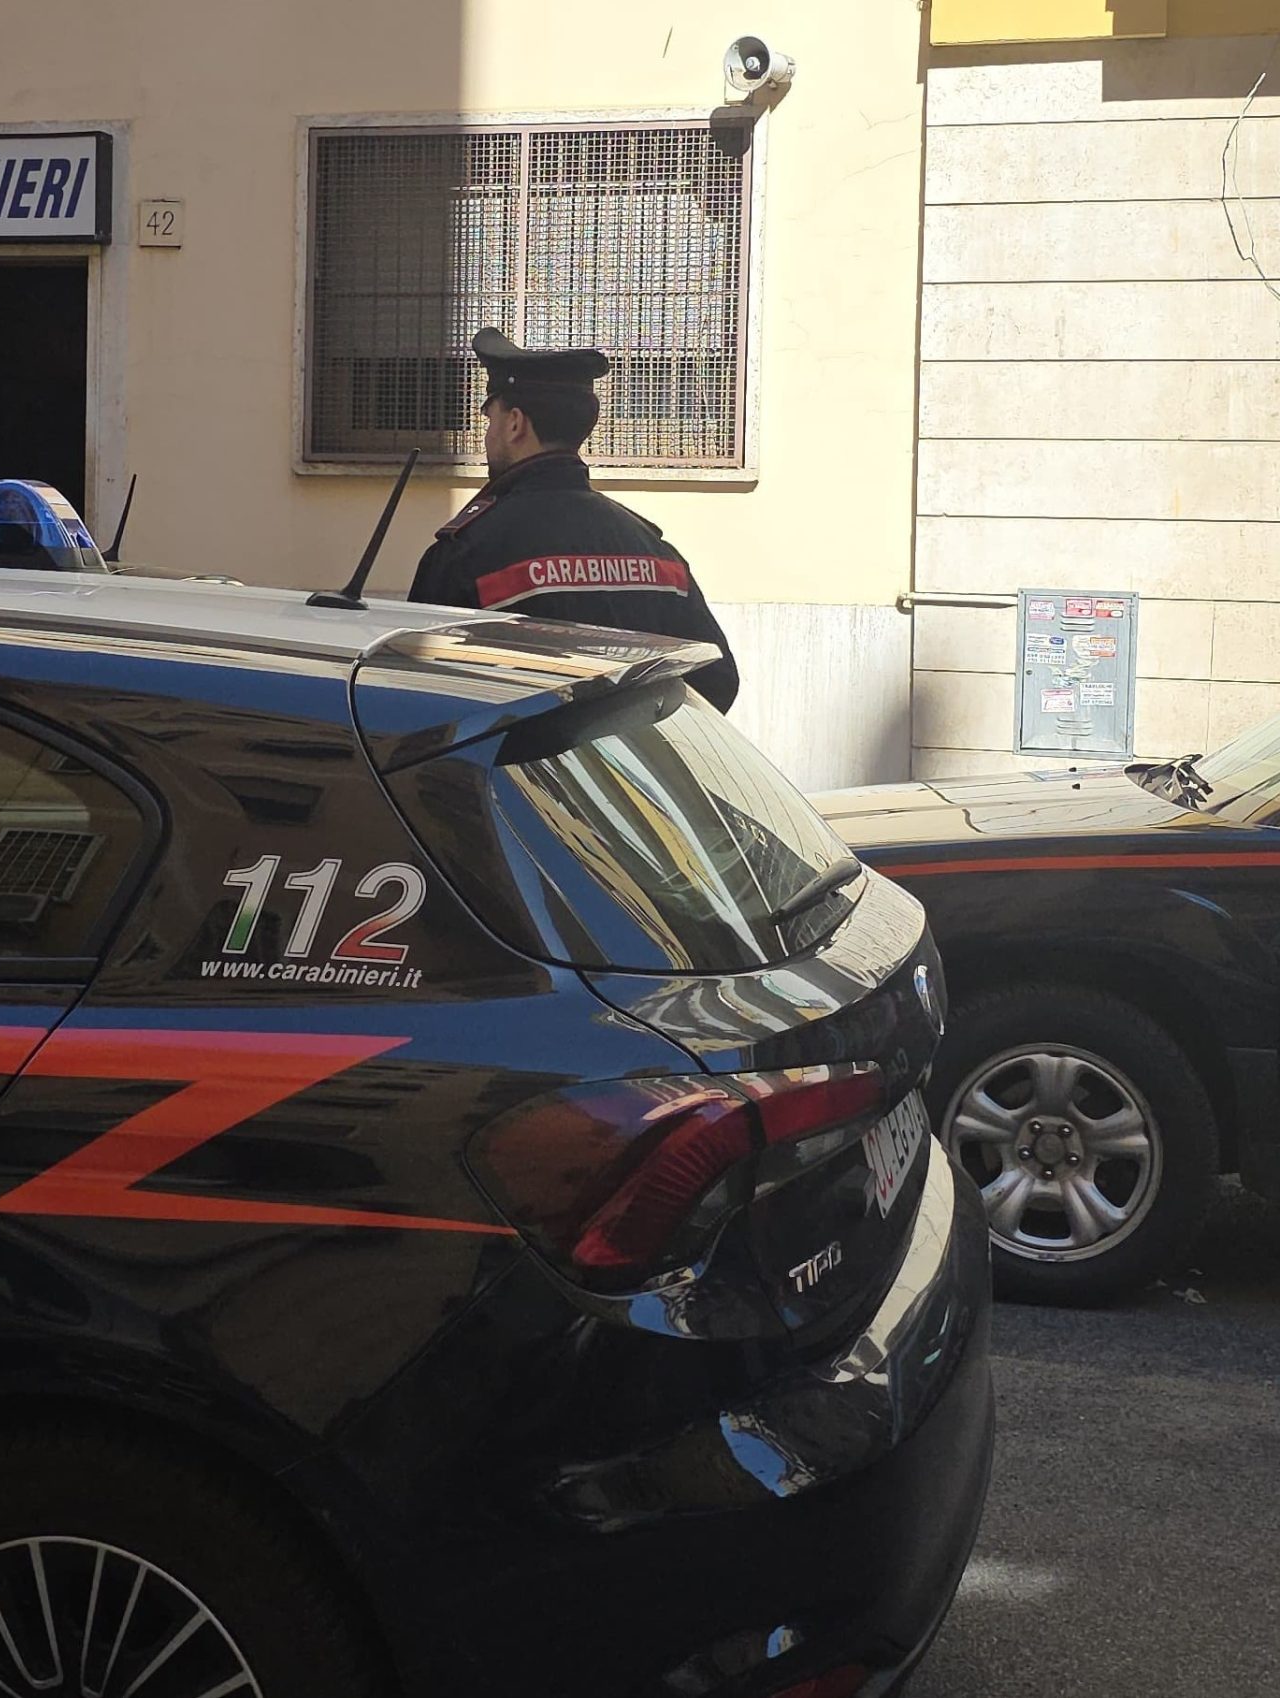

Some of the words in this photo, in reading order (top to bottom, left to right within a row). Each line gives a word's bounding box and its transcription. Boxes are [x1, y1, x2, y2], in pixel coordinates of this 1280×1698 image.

[146, 211, 175, 236] 42
[528, 558, 658, 586] CARABINIERI
[222, 854, 427, 965] 112
[200, 960, 423, 989] www.carabinieri.it
